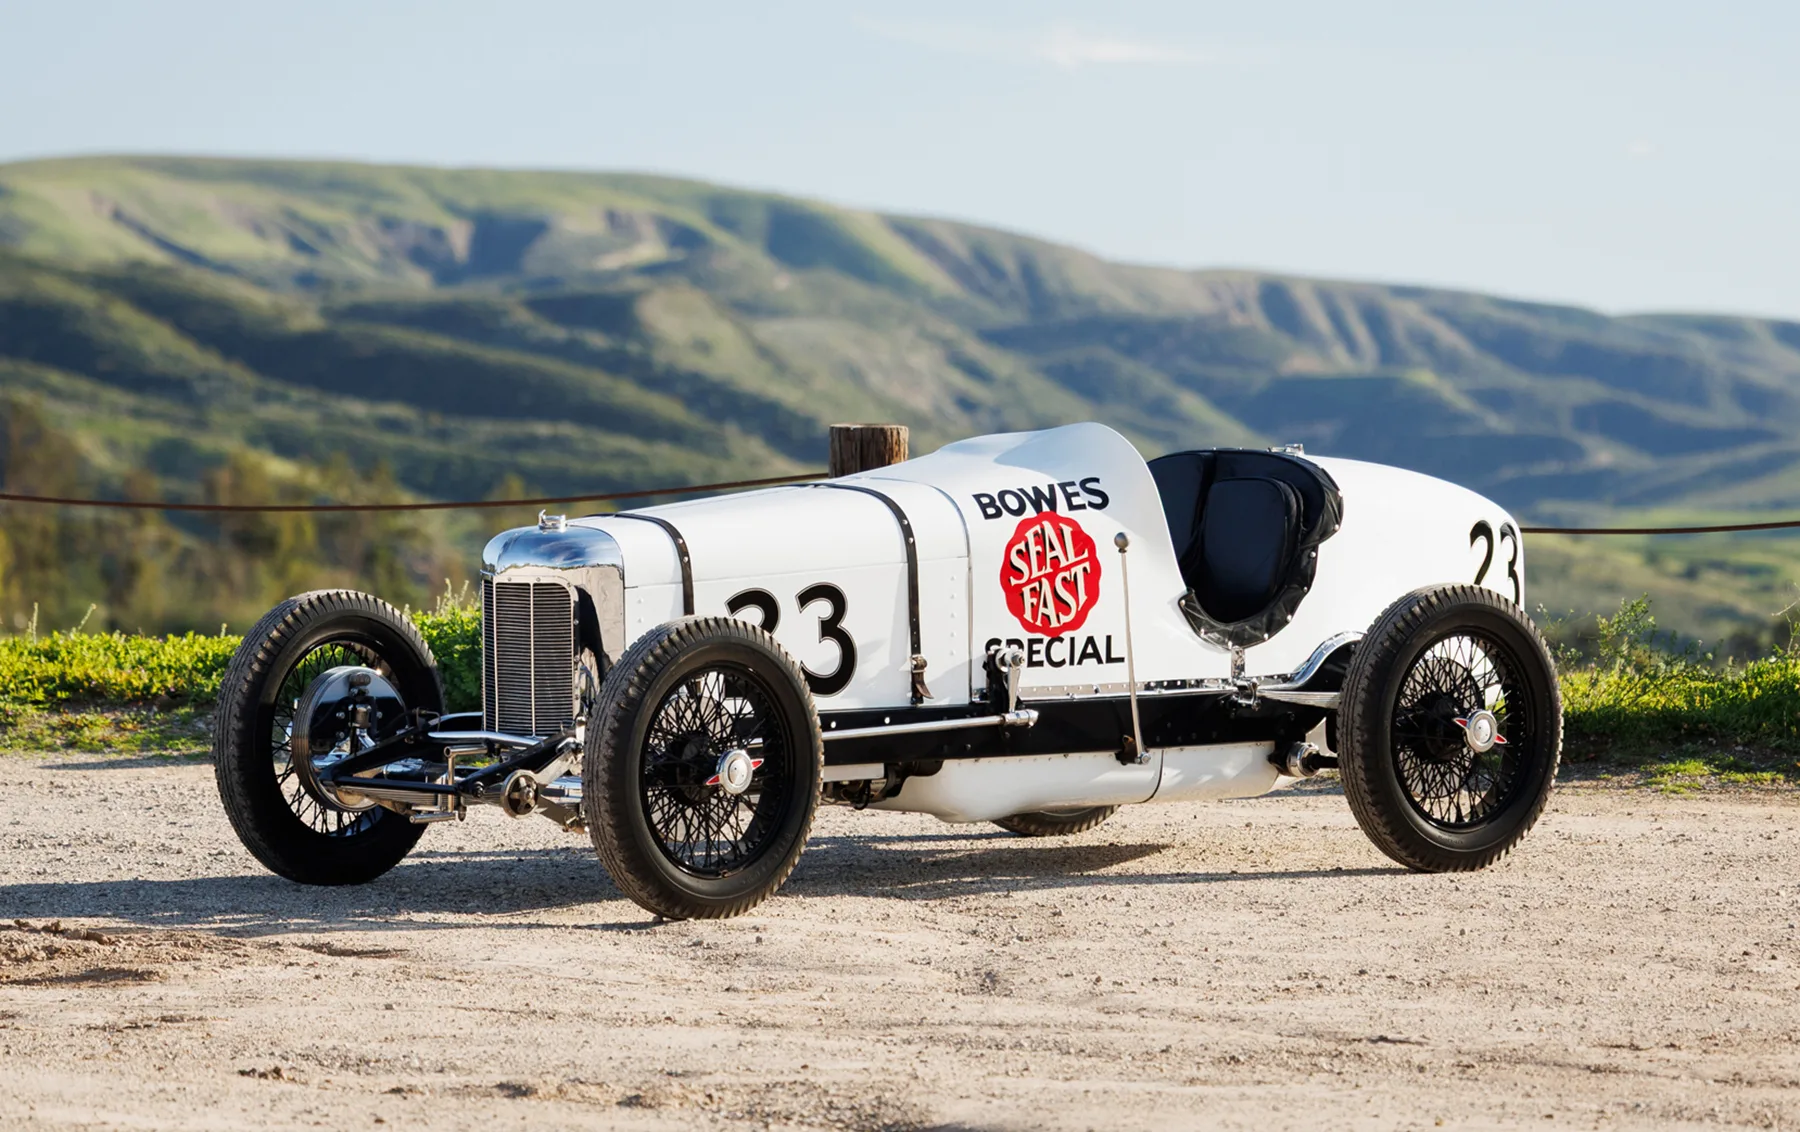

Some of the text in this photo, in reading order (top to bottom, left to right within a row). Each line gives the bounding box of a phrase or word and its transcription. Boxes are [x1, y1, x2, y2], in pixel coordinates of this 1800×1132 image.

[972, 477, 1109, 520] BOWES
[1009, 520, 1088, 586] SEAL
[1021, 561, 1091, 628] FAST
